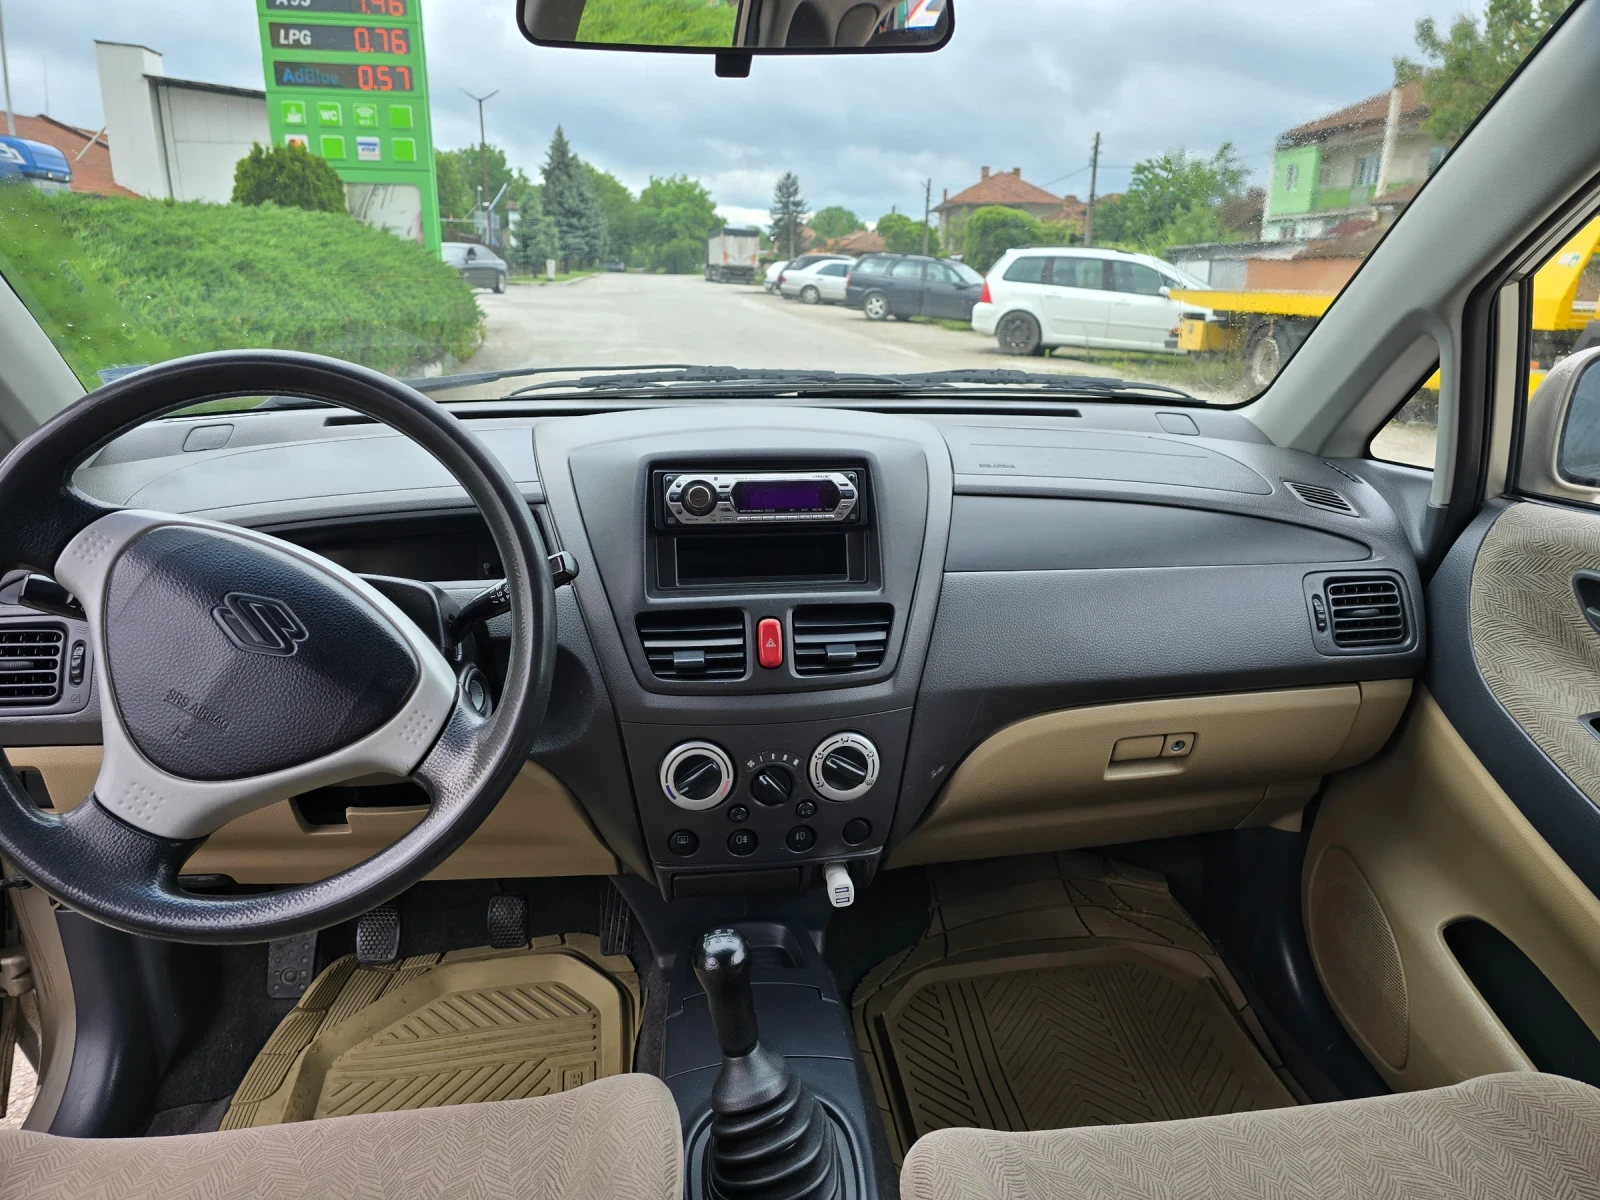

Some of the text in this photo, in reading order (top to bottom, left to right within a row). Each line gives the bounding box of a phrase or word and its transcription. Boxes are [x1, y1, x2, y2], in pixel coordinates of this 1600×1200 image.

[279, 27, 406, 54] LPG 0.76
[282, 65, 410, 91] AdBlue 0.57
[320, 109, 338, 121] WC
[166, 688, 230, 733] SRS AIRBAG
